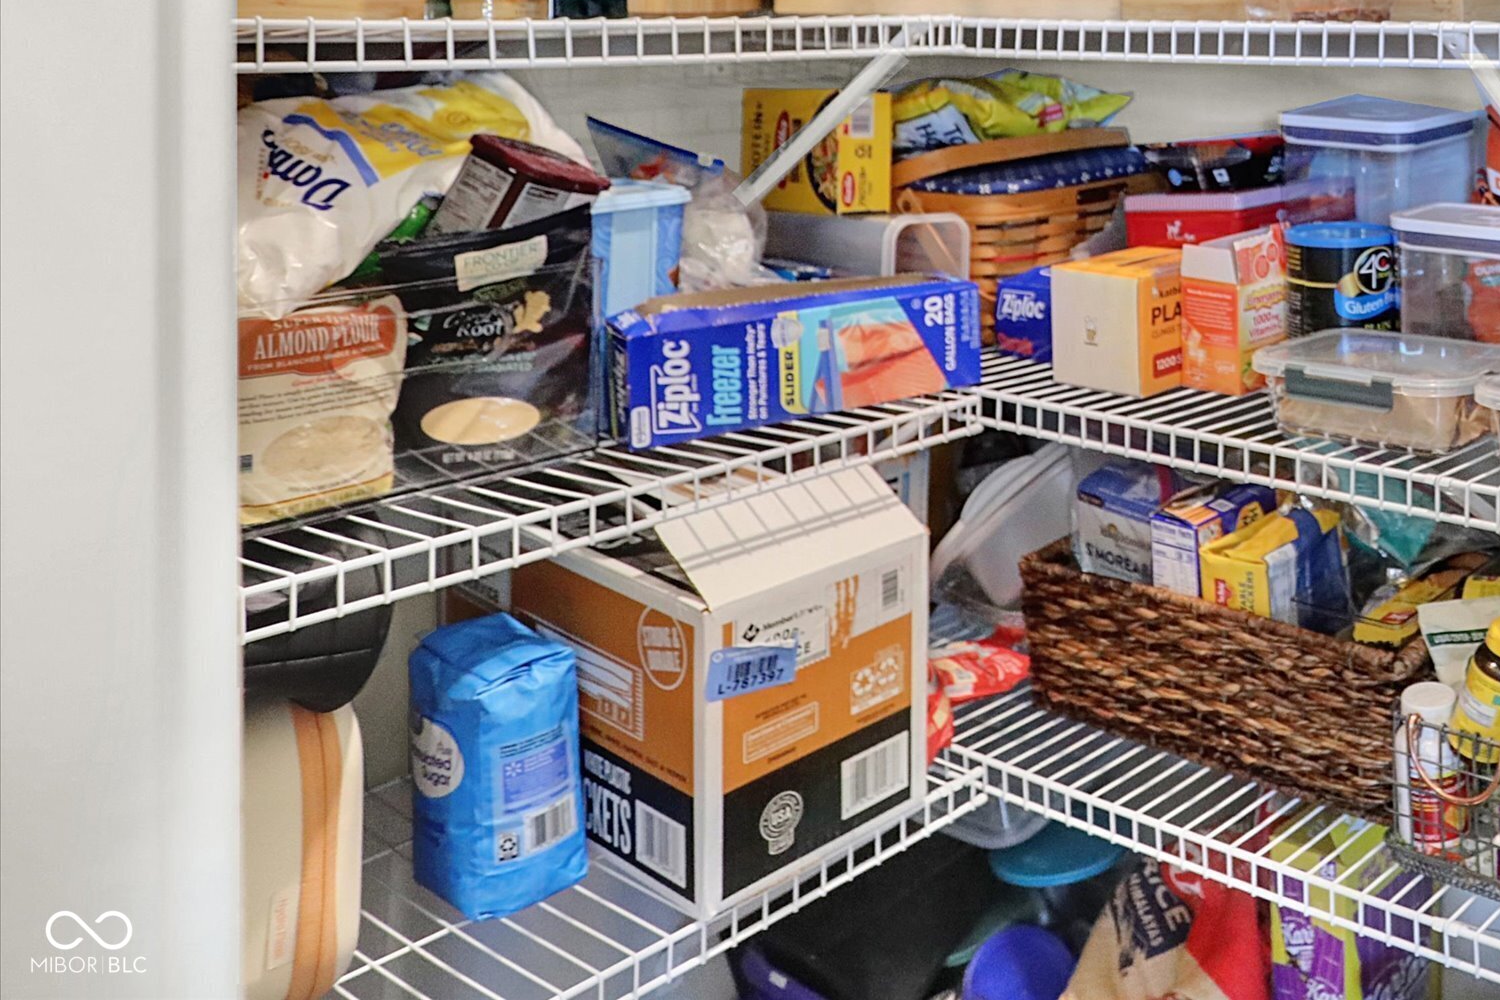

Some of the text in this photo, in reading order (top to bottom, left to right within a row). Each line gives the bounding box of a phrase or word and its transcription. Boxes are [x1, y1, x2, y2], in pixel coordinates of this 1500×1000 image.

[1359, 251, 1391, 289] 4C
[924, 295, 944, 328] 20
[1002, 293, 1046, 322] Ziploc
[1344, 298, 1384, 314] Gluten
[254, 326, 330, 360] ALMOND
[944, 293, 957, 371] GALLON BAGS
[657, 339, 701, 429] Ziploc
[706, 344, 743, 426] Freezer
[747, 354, 757, 379] Than
[785, 350, 795, 407] SLIDER
[747, 379, 758, 420] Stronger
[584, 778, 632, 855] CKETS
